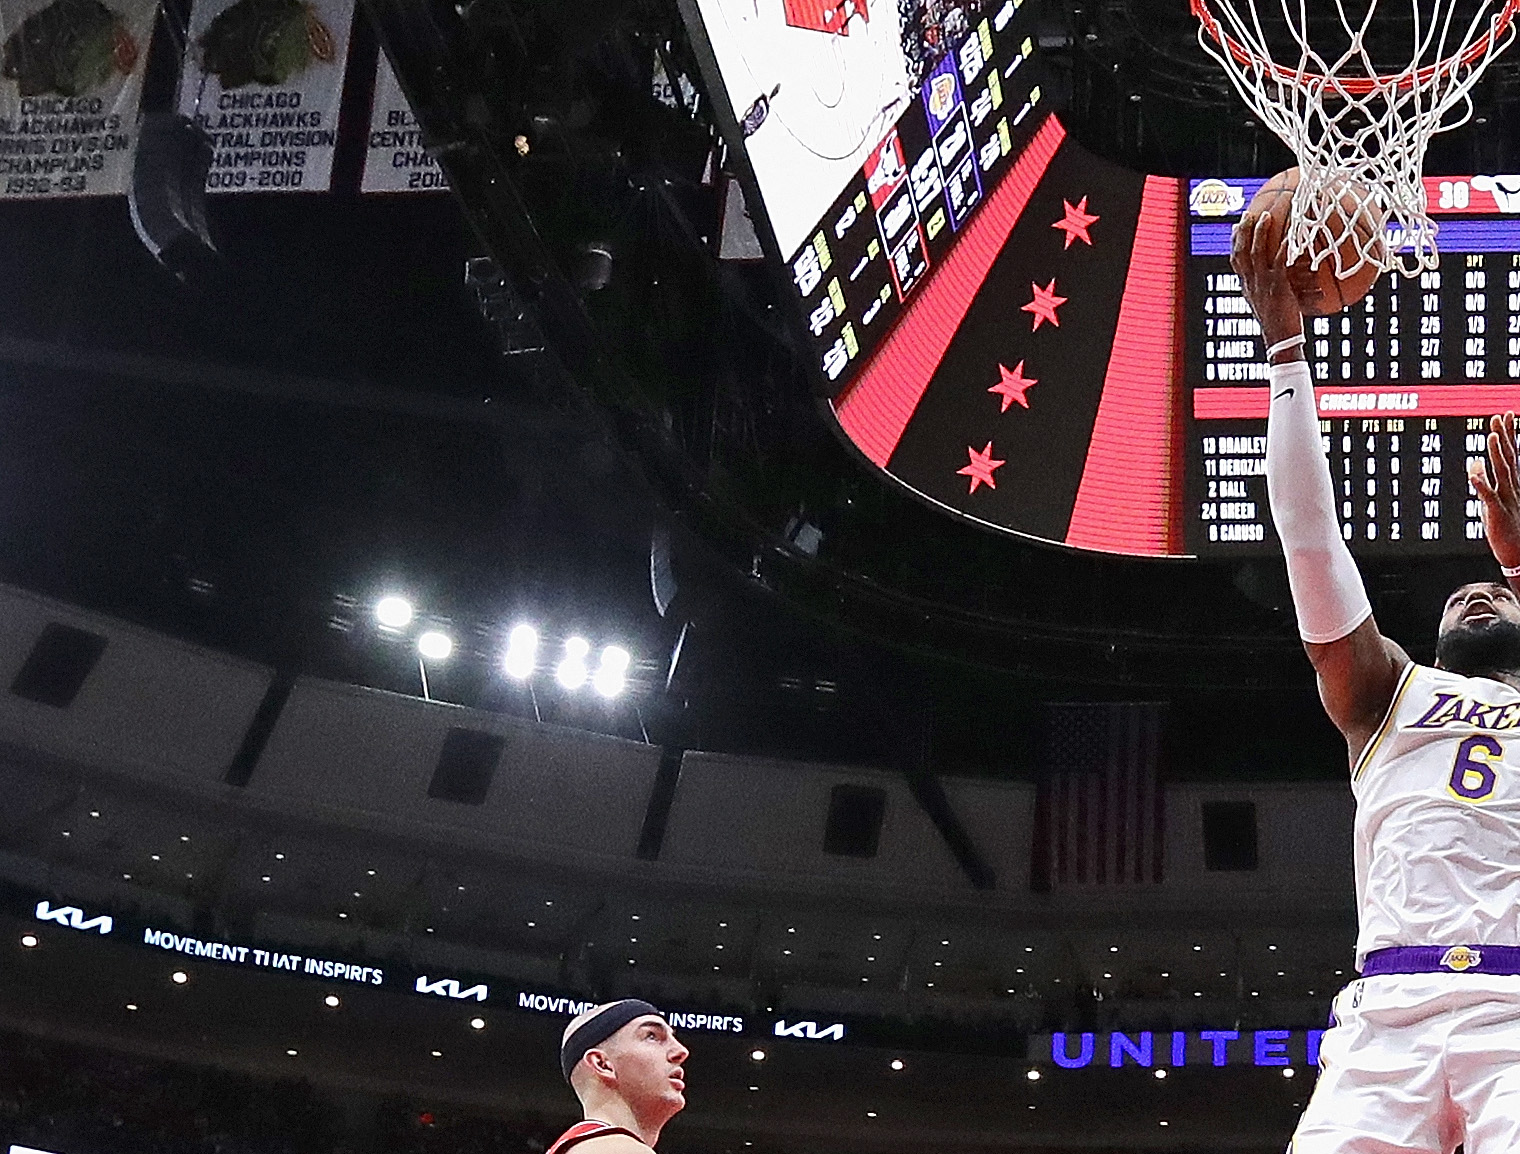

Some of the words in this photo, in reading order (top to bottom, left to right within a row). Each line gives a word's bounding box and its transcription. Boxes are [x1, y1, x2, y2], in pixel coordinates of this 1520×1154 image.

[218, 92, 302, 110] CHICAGO
[211, 131, 255, 148] TRAL
[261, 131, 335, 148] DIVISION
[214, 151, 307, 167] HAMPIONS
[207, 170, 304, 188] 009-2010
[1438, 181, 1469, 209] 30
[1216, 275, 1242, 291] ARIZ
[1204, 297, 1213, 314] 4
[1205, 319, 1214, 336] 7
[1216, 319, 1261, 336] ANTHON
[1320, 393, 1376, 411] CHICAGO
[1378, 393, 1418, 410] BULLS
[1362, 420, 1380, 433] PTS
[1208, 481, 1217, 498] 2
[1219, 481, 1247, 498] BALL
[1201, 503, 1217, 520] 24
[1219, 503, 1255, 519] GREEN
[1220, 524, 1264, 541] CARUSO
[1446, 734, 1503, 804] 6
[36, 901, 113, 934] KIA
[144, 928, 249, 963] MOVEMENT
[304, 958, 383, 986] INSPIRES
[416, 975, 488, 1001] KIA
[774, 1020, 844, 1040] KIA
